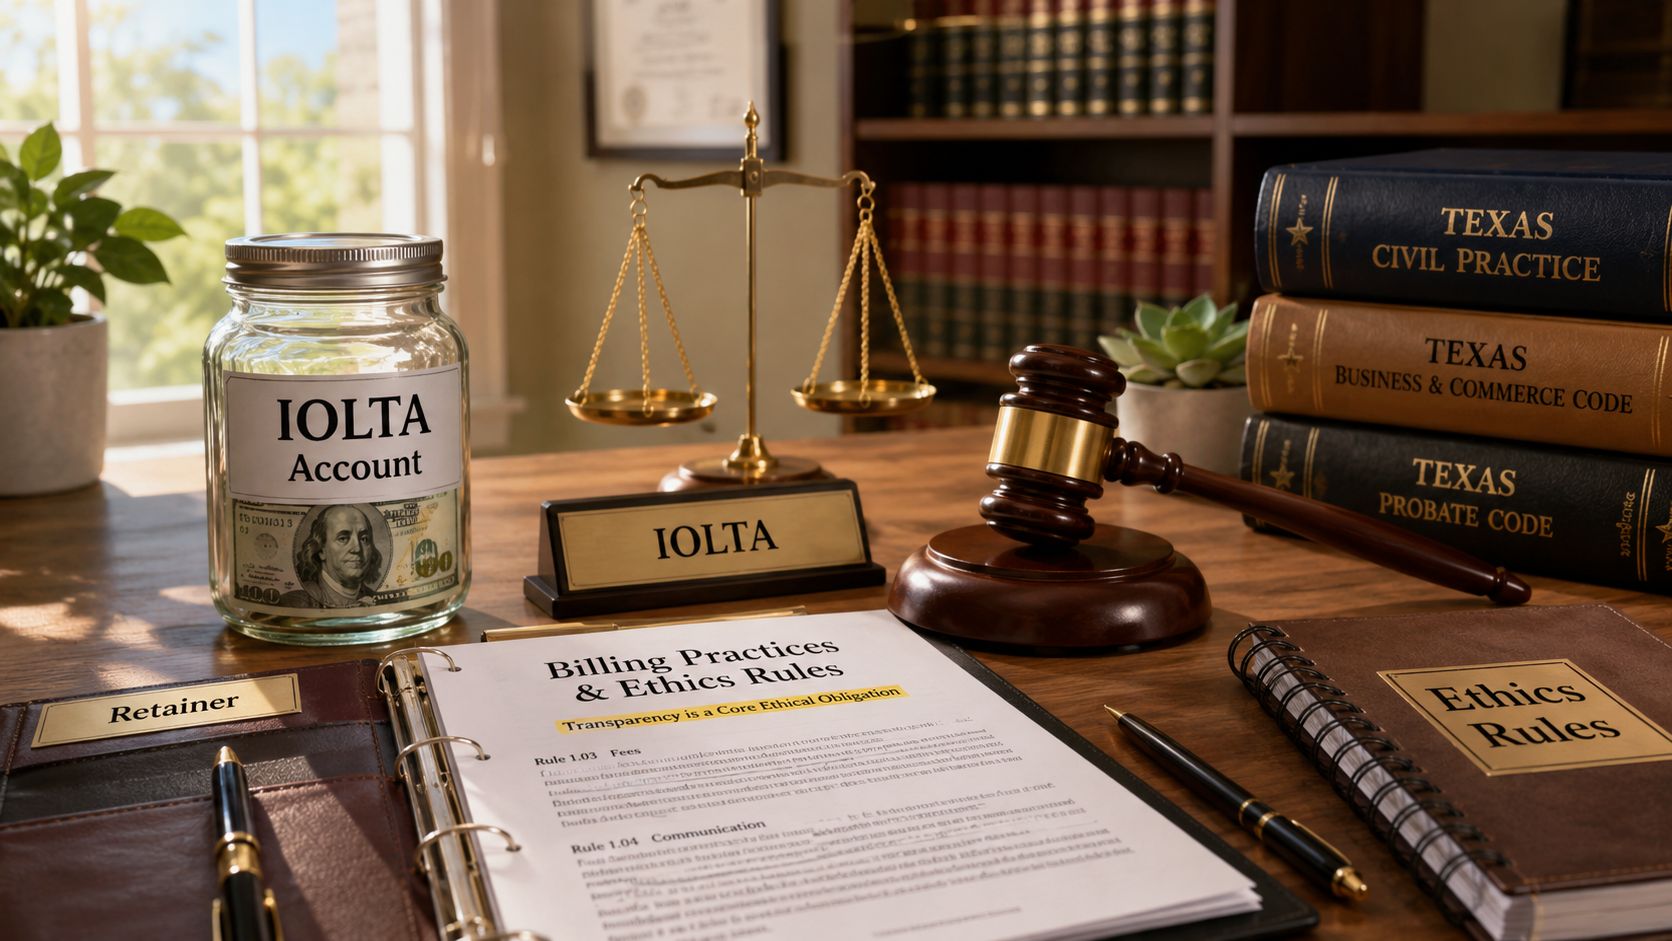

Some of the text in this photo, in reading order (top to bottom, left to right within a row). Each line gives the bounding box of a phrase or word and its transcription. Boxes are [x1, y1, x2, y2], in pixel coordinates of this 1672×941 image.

[1441, 206, 1554, 241] TEXAS
[1371, 243, 1601, 282] CIVIL PRACTICE
[1425, 338, 1528, 372] TEXAS
[1335, 365, 1634, 415] BUSINESS & COMMERCE CODE
[277, 393, 431, 441] IOLTA
[288, 450, 423, 482] Account
[1412, 457, 1518, 497] TEXAS
[1379, 492, 1554, 538] PROBATE CODE
[653, 519, 779, 560] IOLTA
[544, 639, 840, 680] Billing Practices
[575, 661, 844, 703] & Ethics Rules
[1425, 682, 1586, 712] Ethics
[108, 695, 240, 724] Retainer
[562, 687, 901, 732] Transparency is a Core Ethical Obligation
[1467, 717, 1621, 748] Rules
[534, 747, 642, 766] Rule 1.03 Fees
[570, 819, 767, 855] Rule 1.04 Communication
